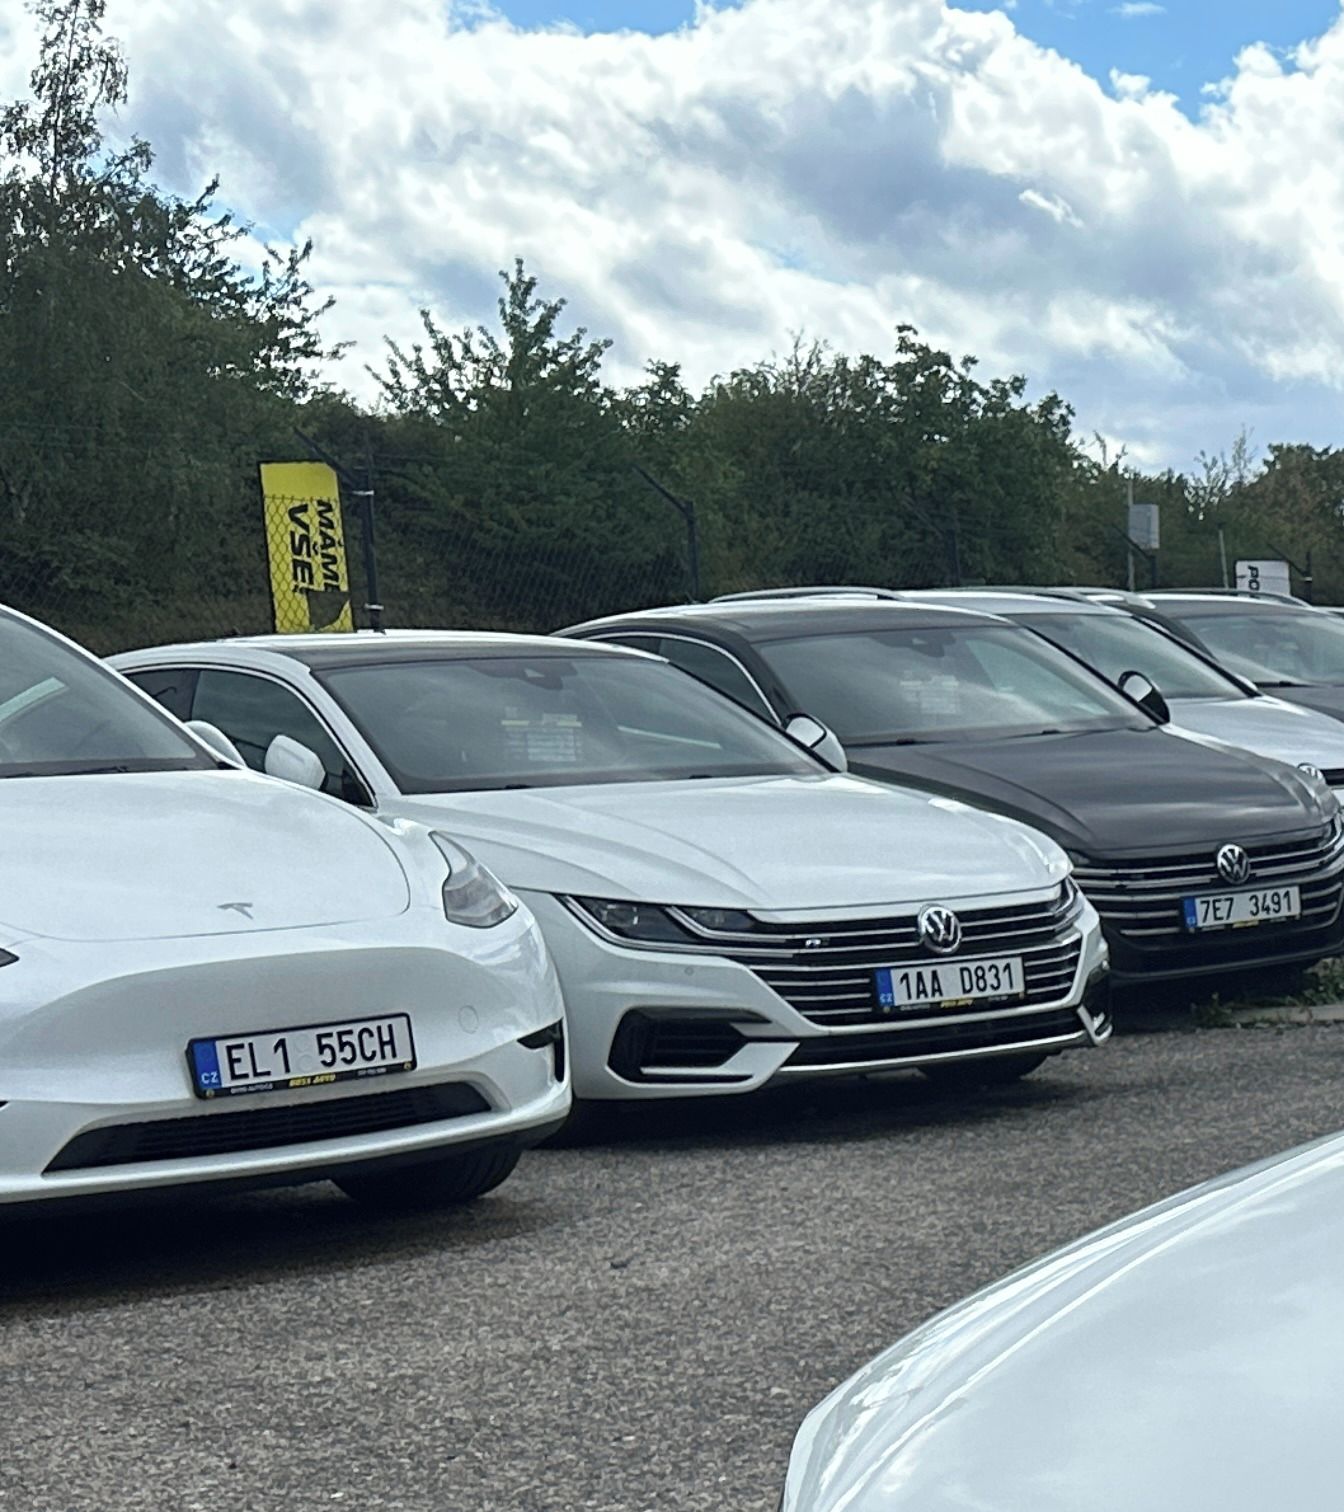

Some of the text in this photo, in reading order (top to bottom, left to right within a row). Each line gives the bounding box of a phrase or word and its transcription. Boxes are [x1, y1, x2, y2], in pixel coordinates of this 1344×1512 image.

[1200, 889, 1291, 924] 7E7 3491
[900, 962, 1014, 1000] 1AA D831
[225, 1023, 397, 1081] EL1 55CH
[200, 1071, 219, 1084] CZ
